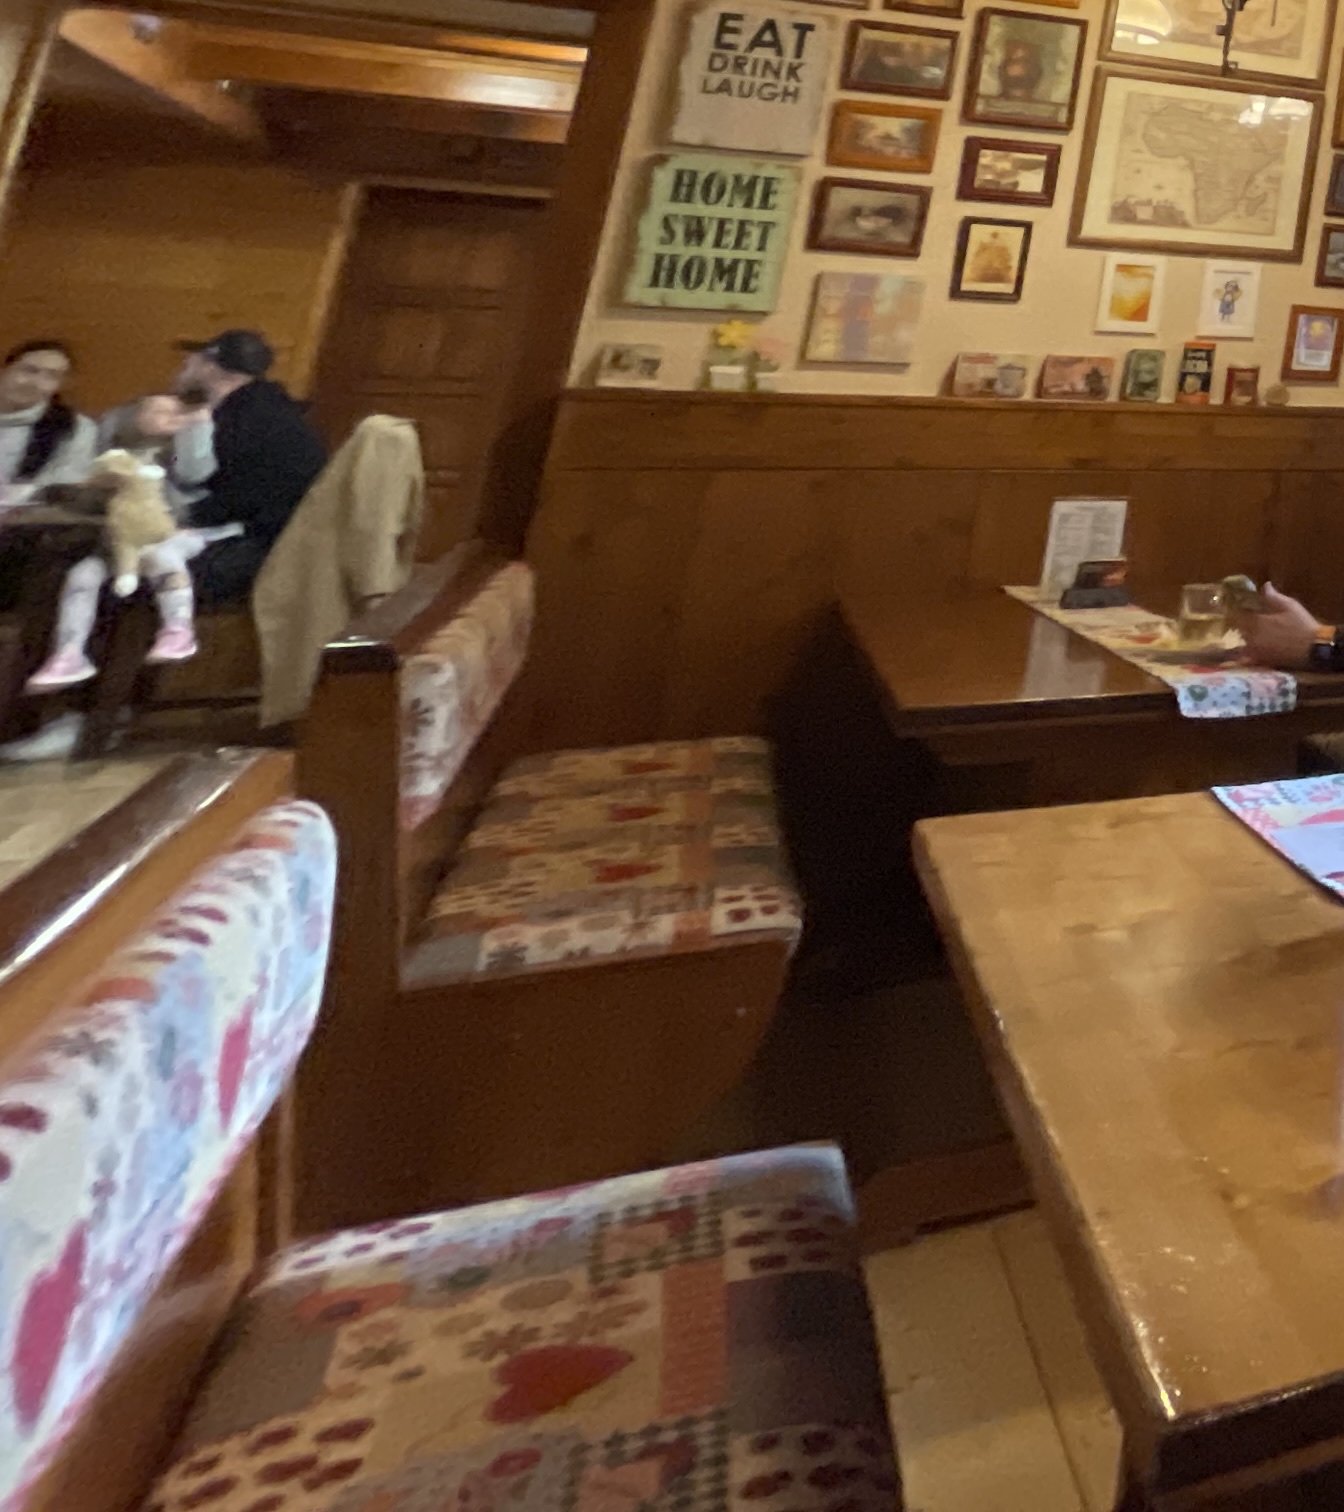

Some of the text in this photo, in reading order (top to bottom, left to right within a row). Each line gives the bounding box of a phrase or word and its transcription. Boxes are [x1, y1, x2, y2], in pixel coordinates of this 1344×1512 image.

[713, 12, 816, 60] EAT
[707, 51, 805, 85] DRINK
[700, 78, 800, 105] LAUGH
[669, 168, 781, 211] HOME
[659, 213, 776, 252] SWEET
[650, 253, 763, 294] HOME
